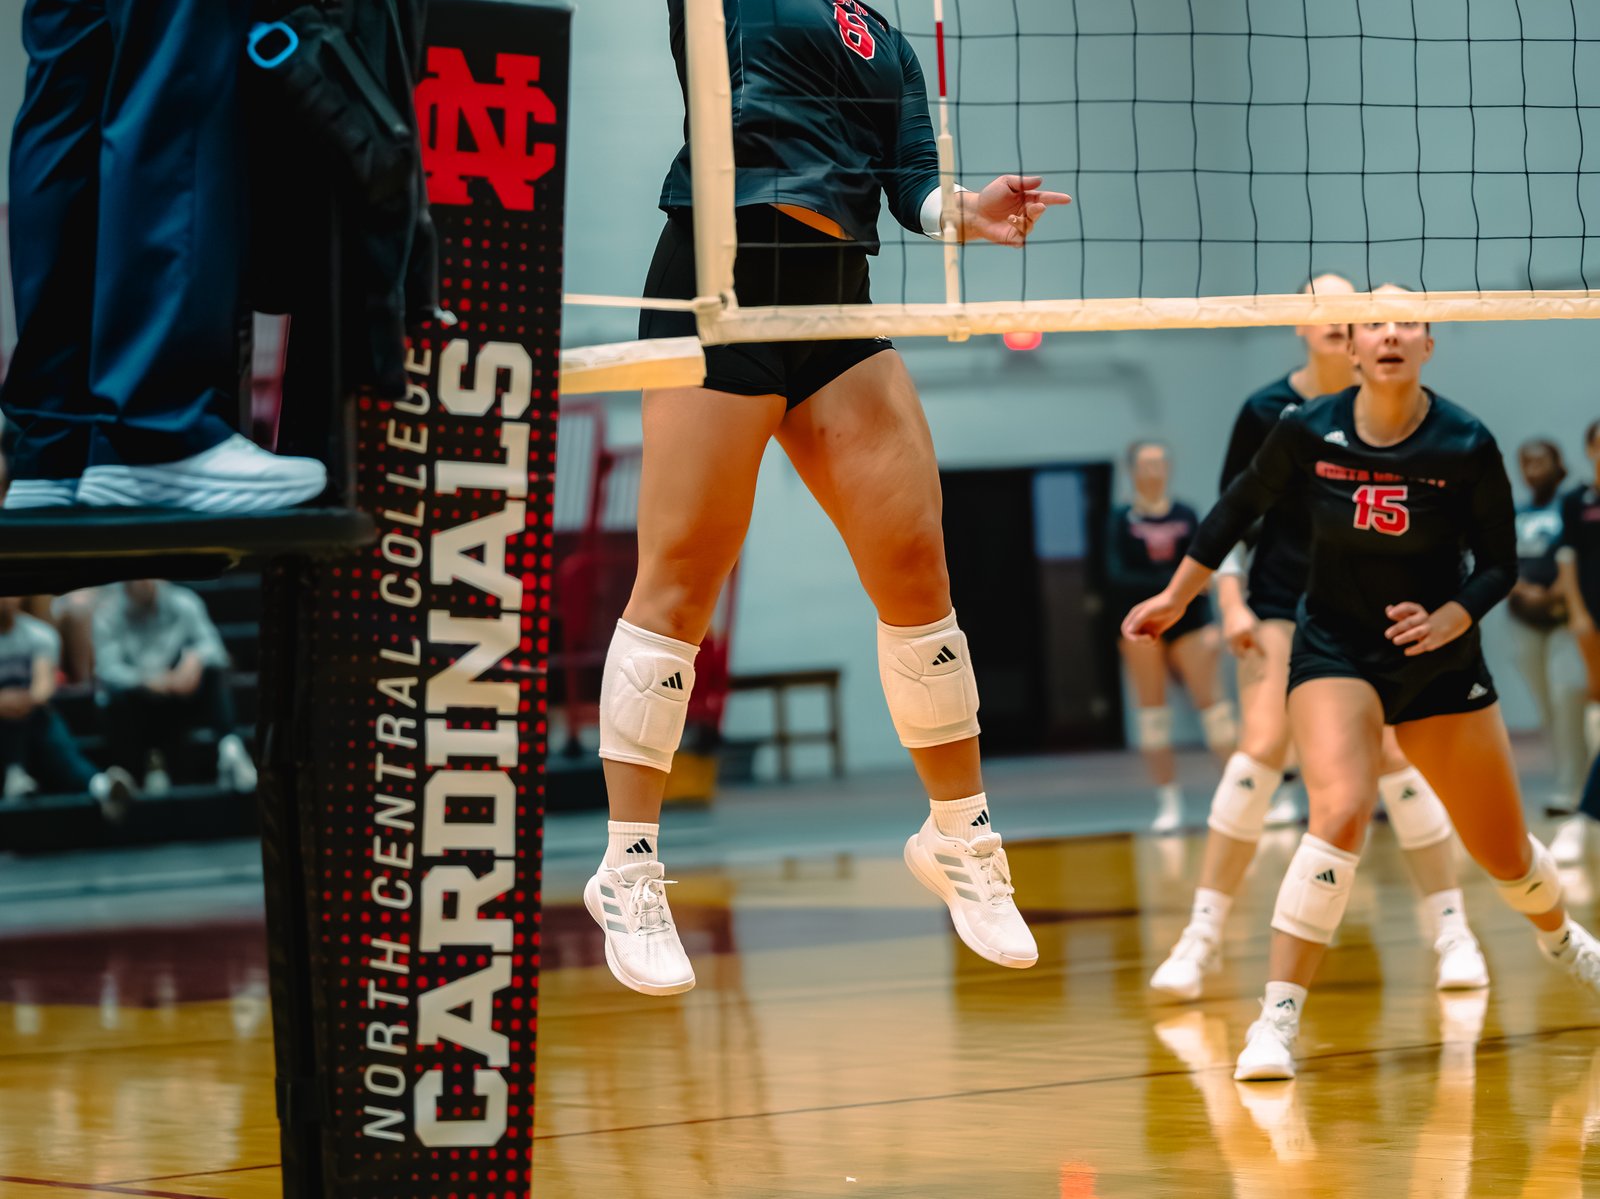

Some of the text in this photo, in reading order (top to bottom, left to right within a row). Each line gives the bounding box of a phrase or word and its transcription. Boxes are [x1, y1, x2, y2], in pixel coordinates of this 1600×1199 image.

[833, 2, 876, 60] 6
[1352, 484, 1410, 536] 15
[363, 346, 432, 1142] NORTH CENTRAL COLLEGE
[413, 337, 533, 1148] CARDINALS
